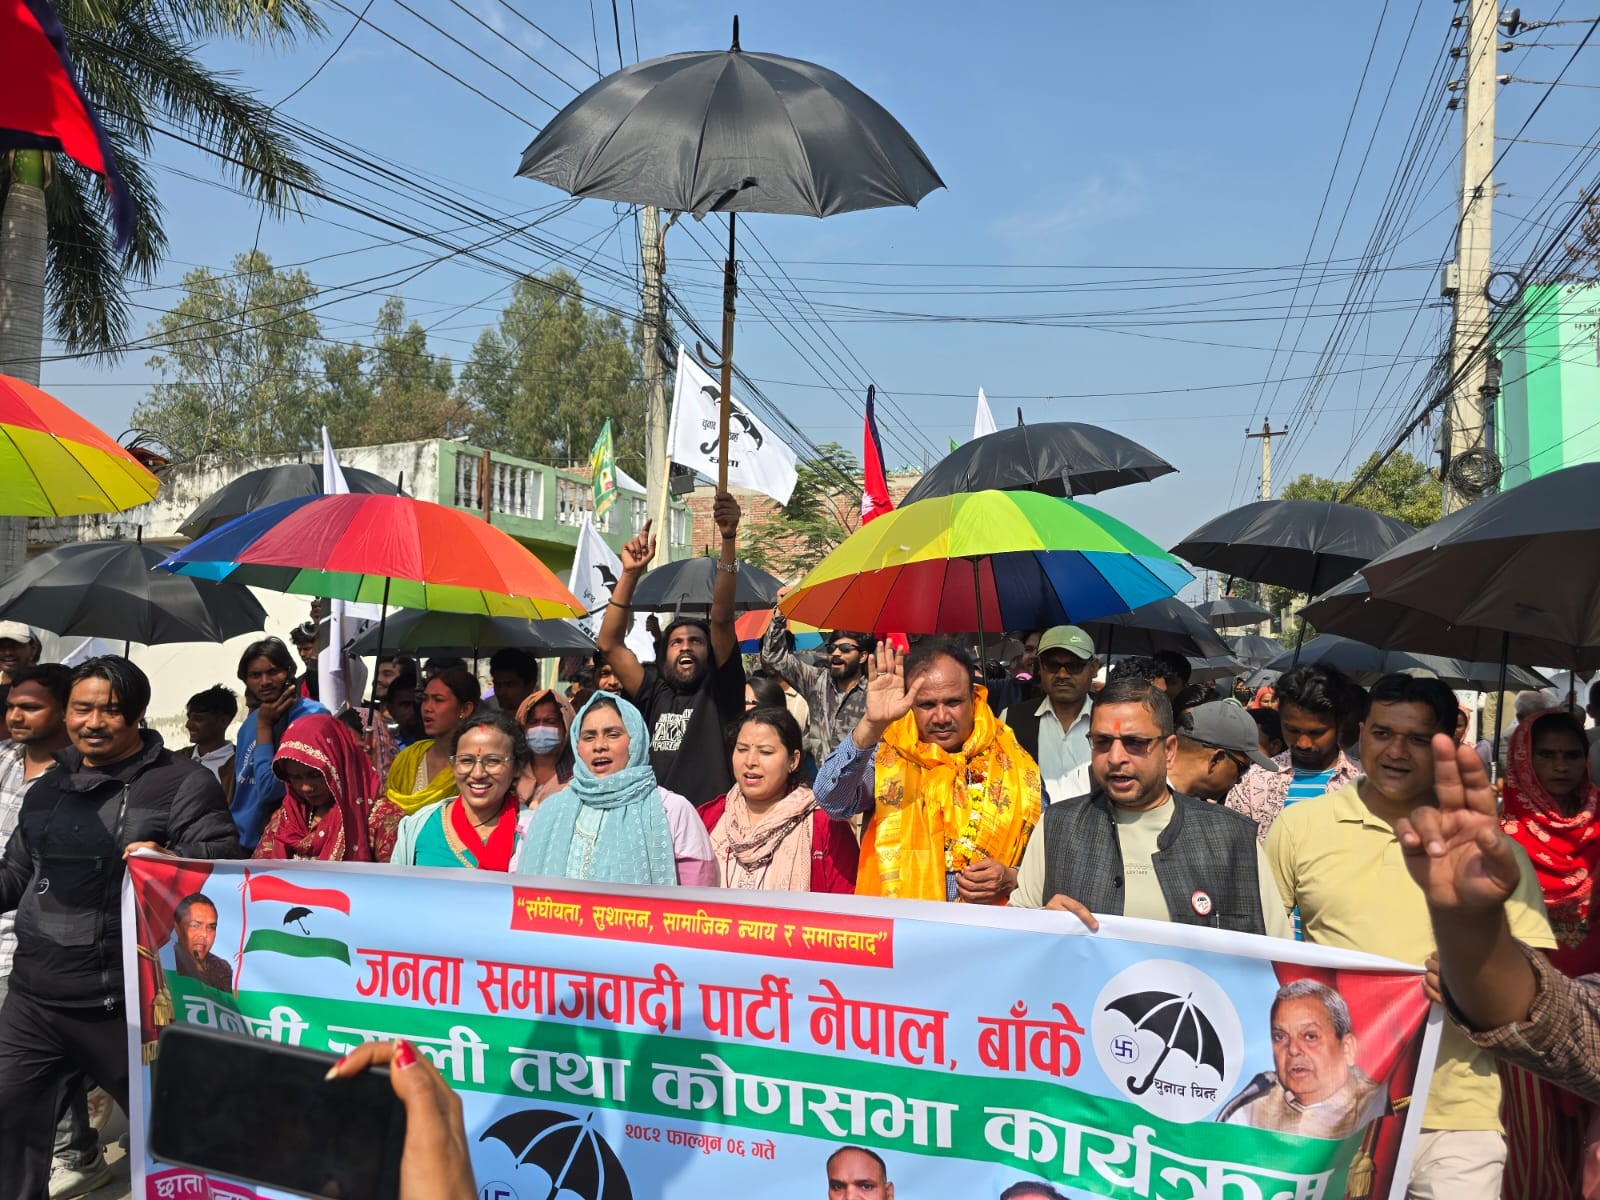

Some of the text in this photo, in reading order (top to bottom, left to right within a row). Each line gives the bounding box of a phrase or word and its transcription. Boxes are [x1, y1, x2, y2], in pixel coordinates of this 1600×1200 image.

[518, 897, 887, 956] “संघीयता, सुशासन, सामाजिक न्याय र समाजवाद”
[356, 947, 1086, 1078] जनता समाजवादी पार्टी नेपाल, बाँके
[508, 1046, 632, 1102] तथा
[651, 1053, 960, 1149] कोणसभा
[1153, 1078, 1218, 1102] चुनाव चिन्ह
[625, 1124, 776, 1160] २०८२ फाल्गुन ०६ गते
[155, 1174, 203, 1199] छाता
